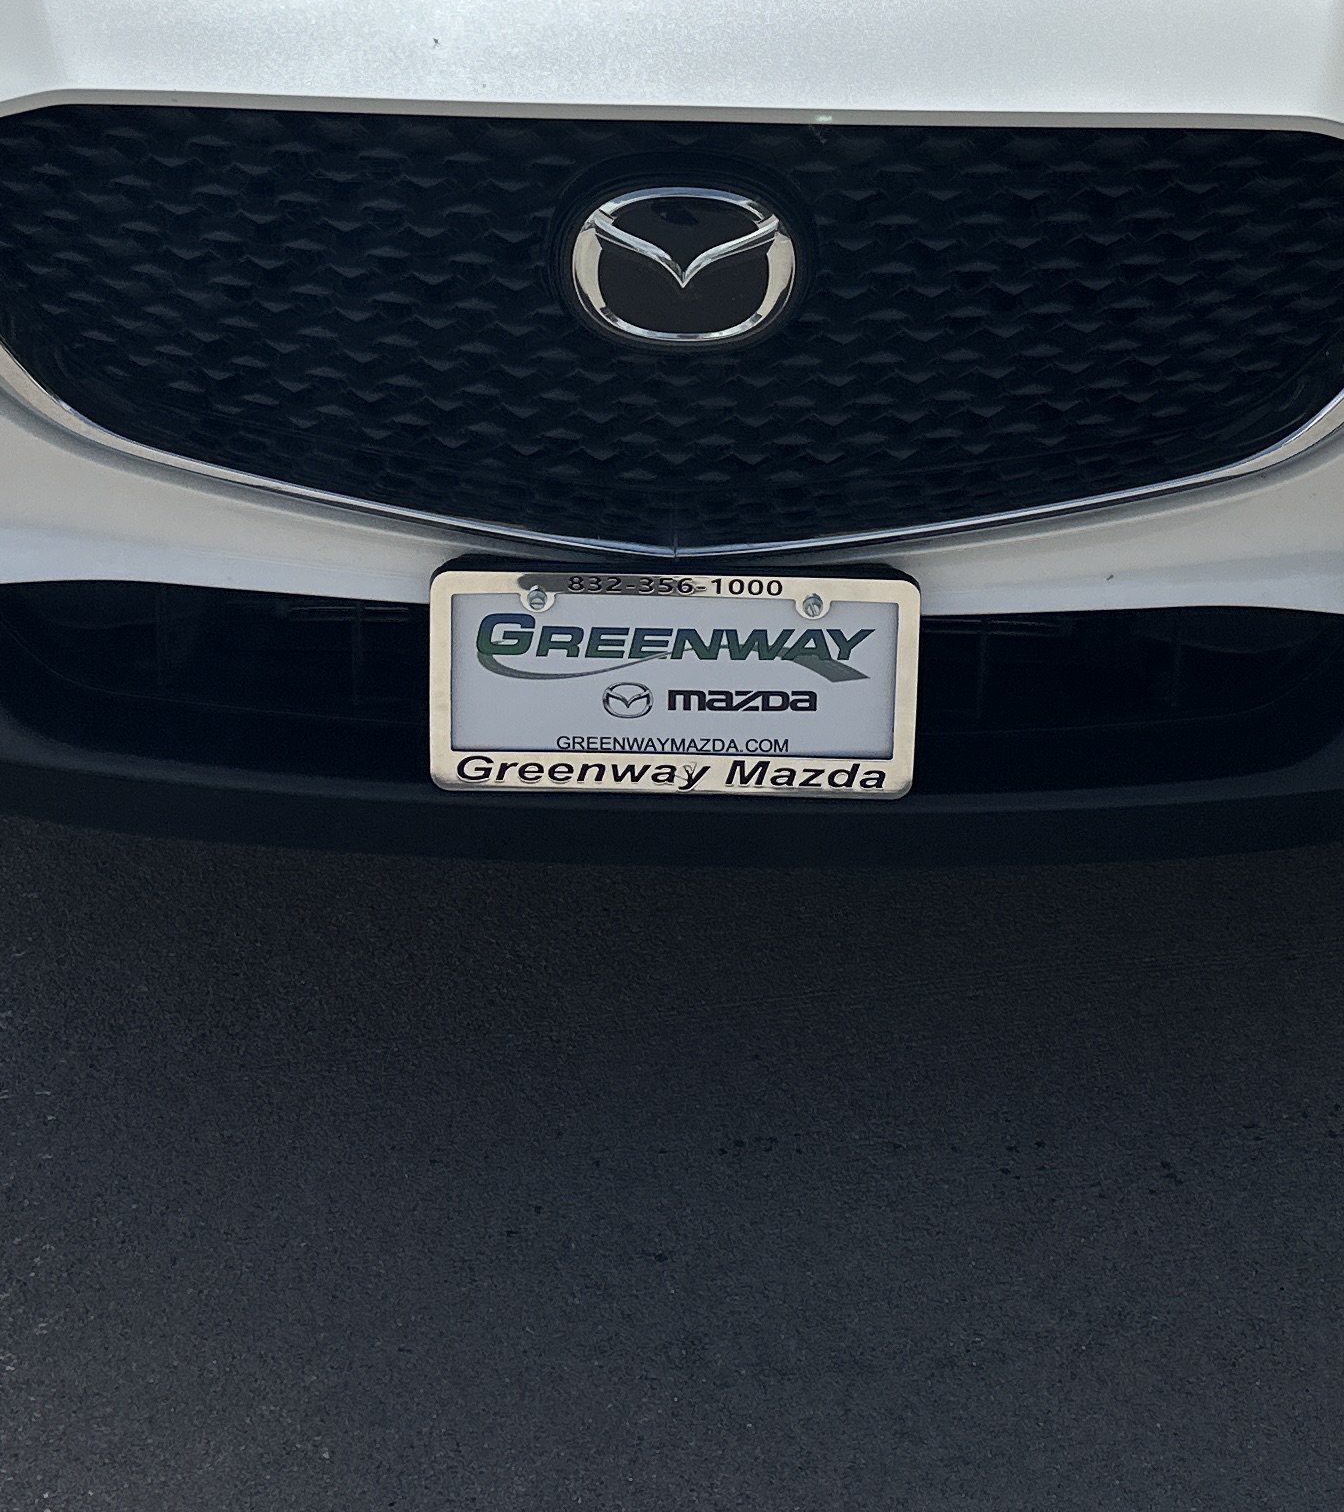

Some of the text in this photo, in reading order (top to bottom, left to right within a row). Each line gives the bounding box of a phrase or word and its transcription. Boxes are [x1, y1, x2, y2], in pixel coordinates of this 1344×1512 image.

[567, 575, 784, 597] 832-356-1000
[476, 612, 877, 661] GREENWAY
[667, 689, 818, 712] mazda
[556, 735, 790, 753] GREENWAYMAZDA.COM
[456, 755, 887, 791] Greenway Mazda
